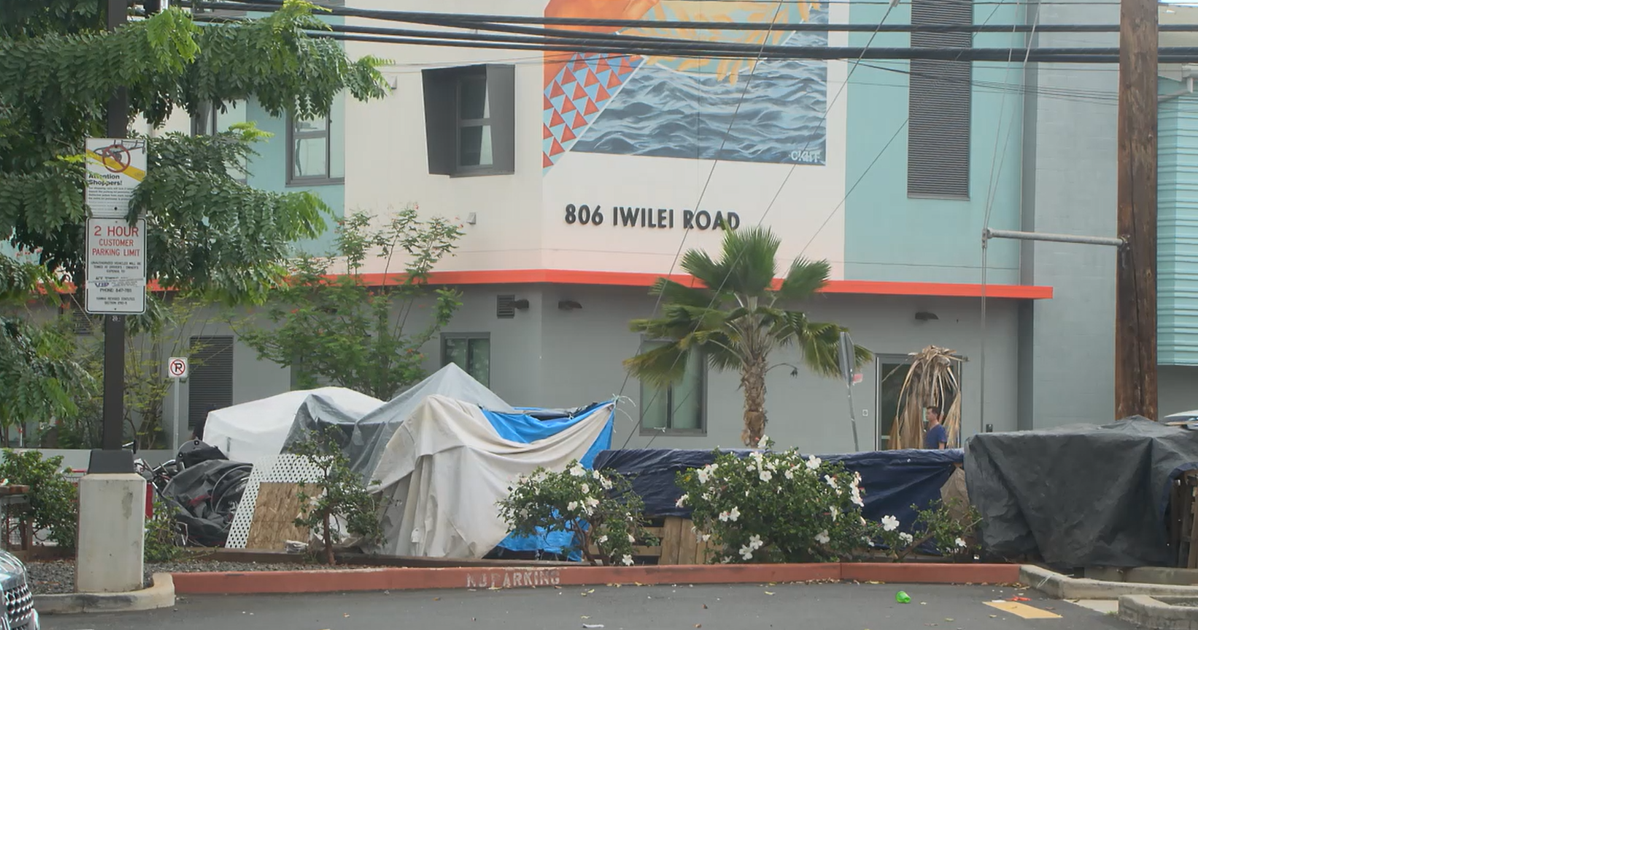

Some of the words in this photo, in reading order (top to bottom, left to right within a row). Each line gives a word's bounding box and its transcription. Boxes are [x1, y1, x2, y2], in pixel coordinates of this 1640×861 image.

[564, 203, 604, 226] 806
[613, 206, 674, 229] IWILEI
[683, 209, 740, 231] ROAD
[94, 225, 102, 237] 2
[107, 225, 139, 237] HOUR
[98, 238, 134, 247] CUSTOMER
[92, 248, 120, 256] PARKING
[123, 248, 140, 257] LIMIT
[491, 570, 560, 588] PARKING
